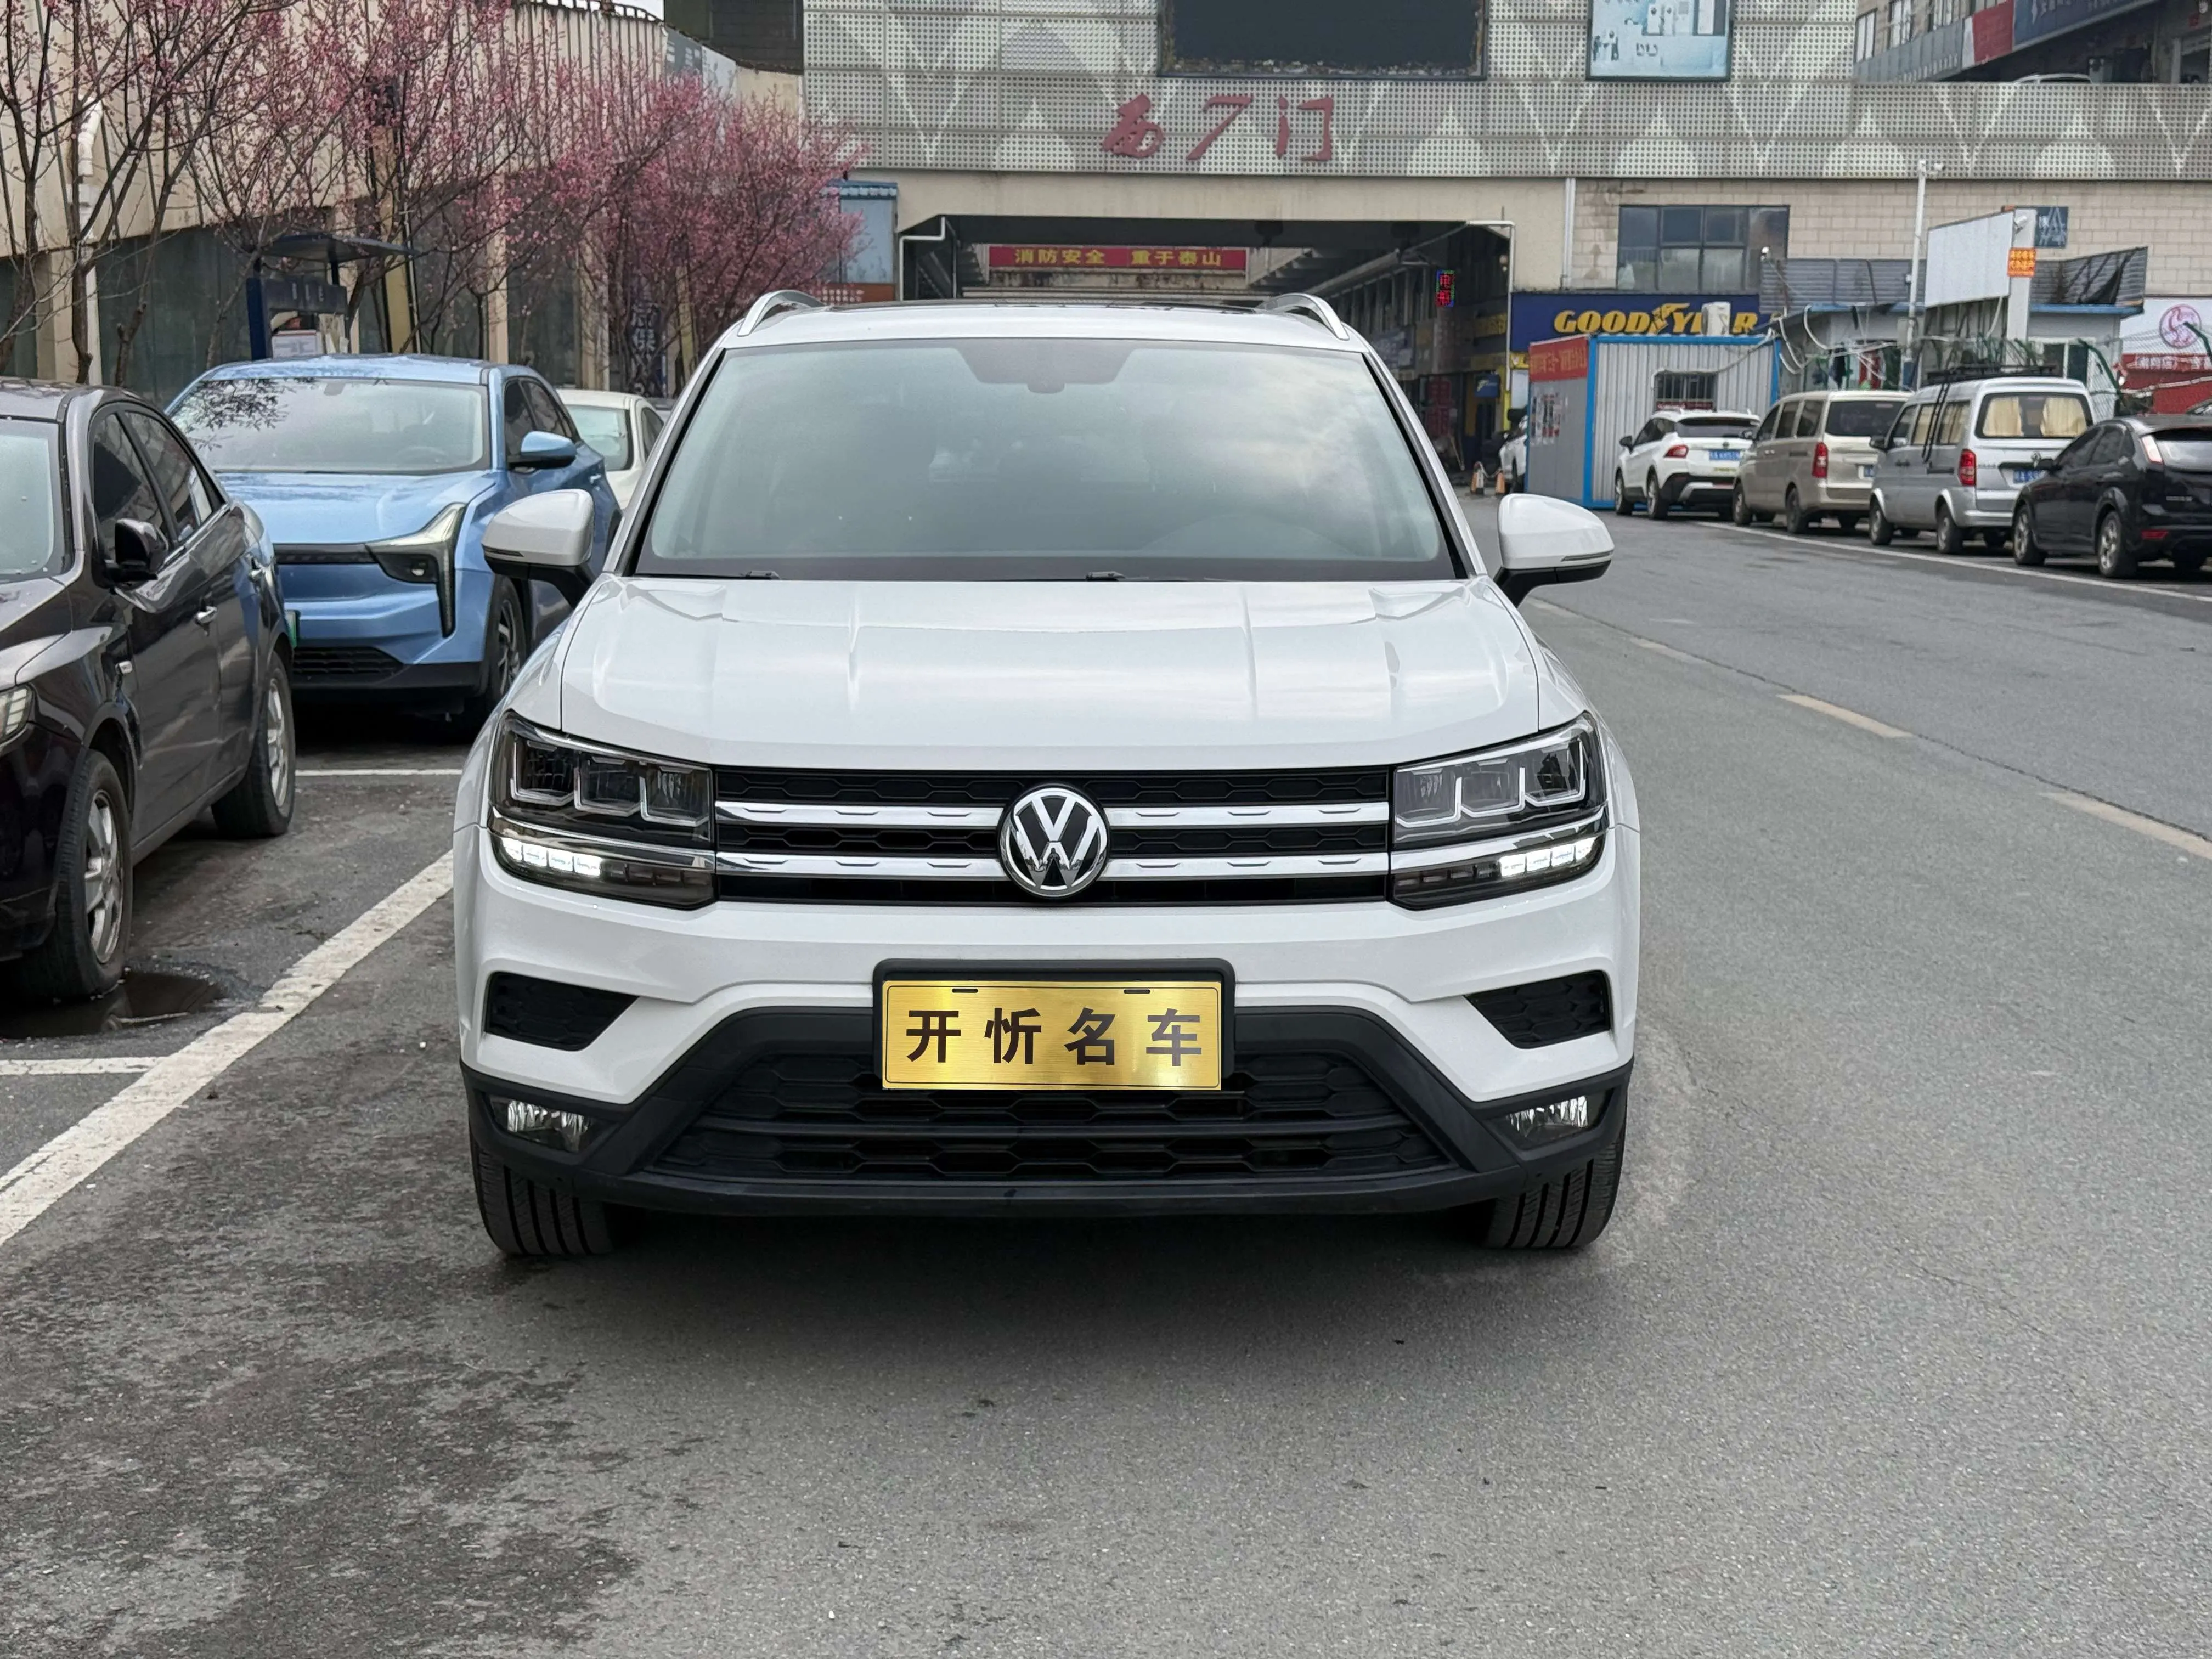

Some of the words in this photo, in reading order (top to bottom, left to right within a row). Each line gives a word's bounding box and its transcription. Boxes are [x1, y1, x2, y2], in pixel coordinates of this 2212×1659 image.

[1015, 248, 1106, 264] 消防安全
[1131, 249, 1222, 266] 重于泰山
[1554, 309, 1758, 334] GOODYR
[906, 1007, 1202, 1066] 开忻名车
